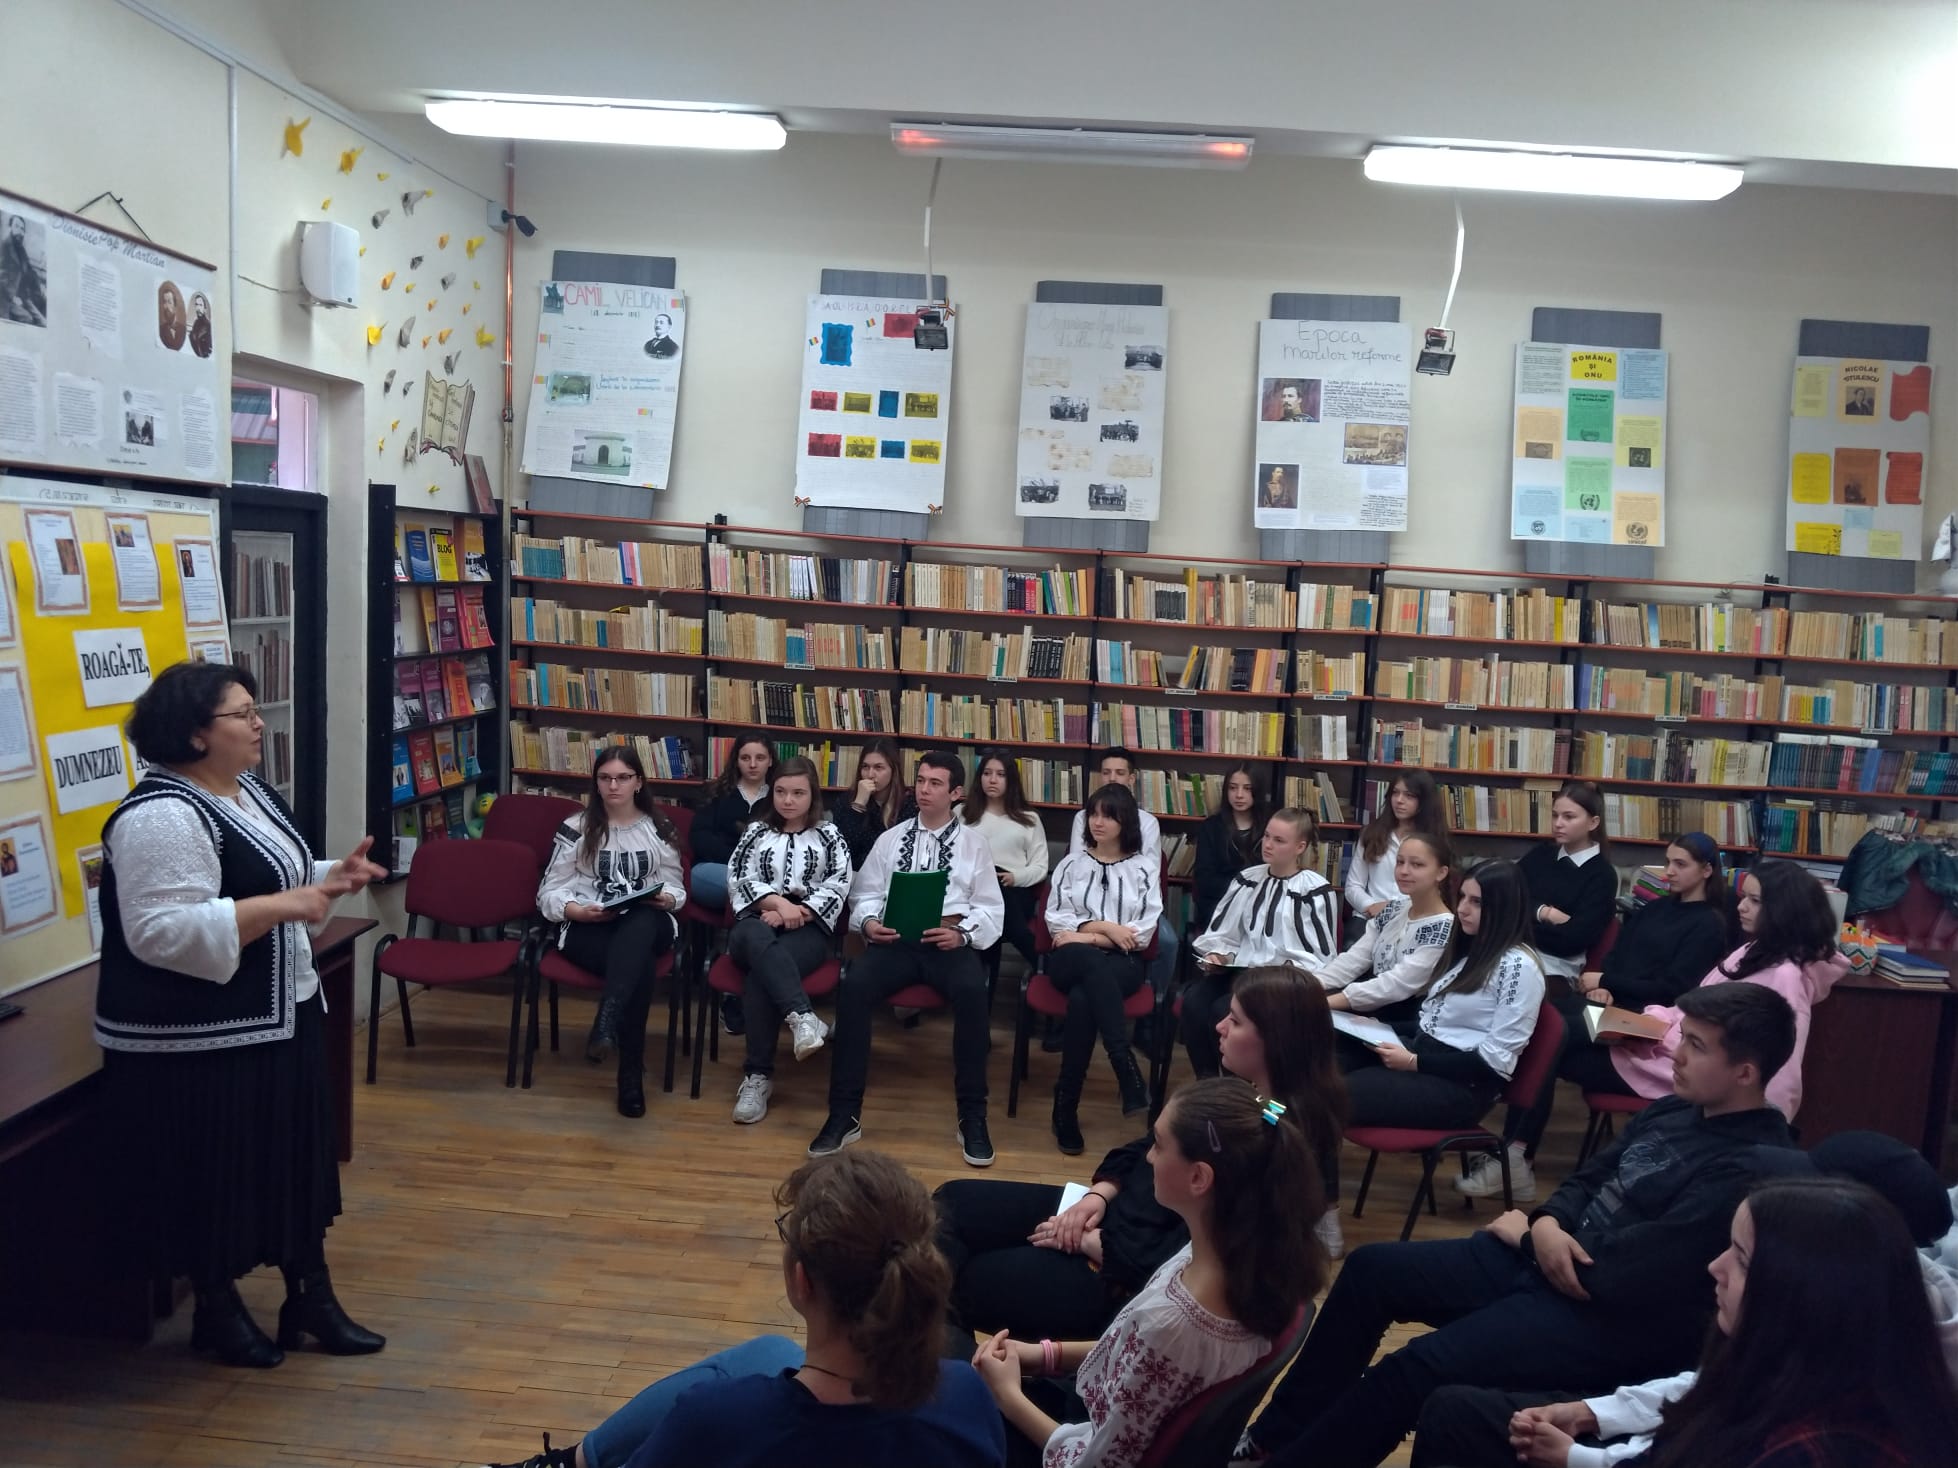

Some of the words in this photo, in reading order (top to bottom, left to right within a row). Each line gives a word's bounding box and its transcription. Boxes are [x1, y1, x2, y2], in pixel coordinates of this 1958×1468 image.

[1297, 320, 1368, 352] Epoca
[1572, 353, 1612, 364] ROMÂNIA
[1845, 365, 1879, 373] NICOLAE
[80, 642, 151, 681] ROAGĂ-TE,
[54, 745, 122, 789] DUMNEZEU
